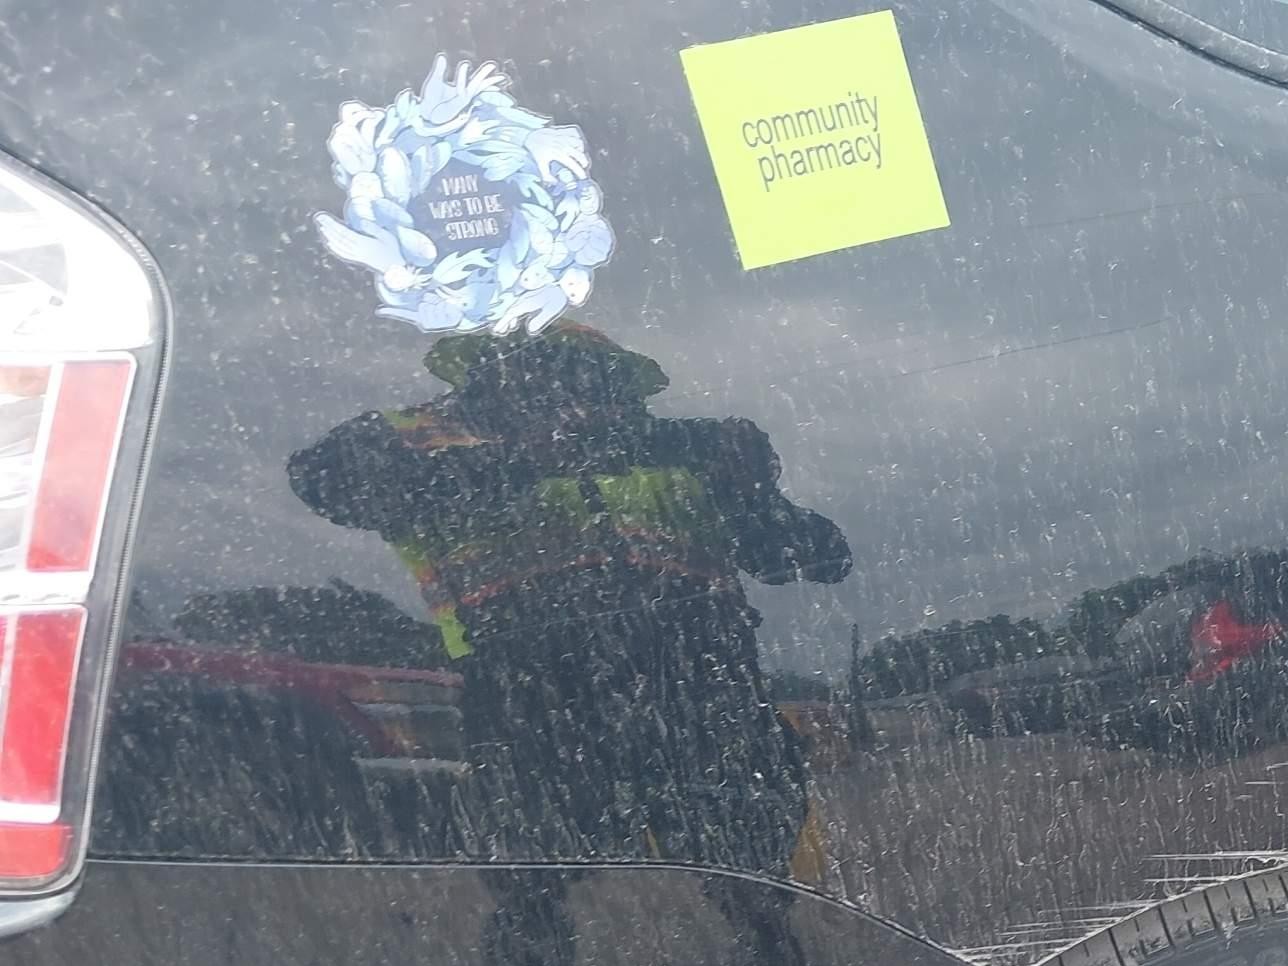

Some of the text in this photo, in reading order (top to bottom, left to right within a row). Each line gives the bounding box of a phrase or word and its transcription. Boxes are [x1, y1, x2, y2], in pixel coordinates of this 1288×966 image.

[741, 91, 880, 148] community
[757, 133, 883, 192] pharmacy
[441, 174, 479, 196] MANY
[462, 197, 483, 215] TO
[483, 193, 505, 213] BE
[445, 217, 500, 240] STRONG
